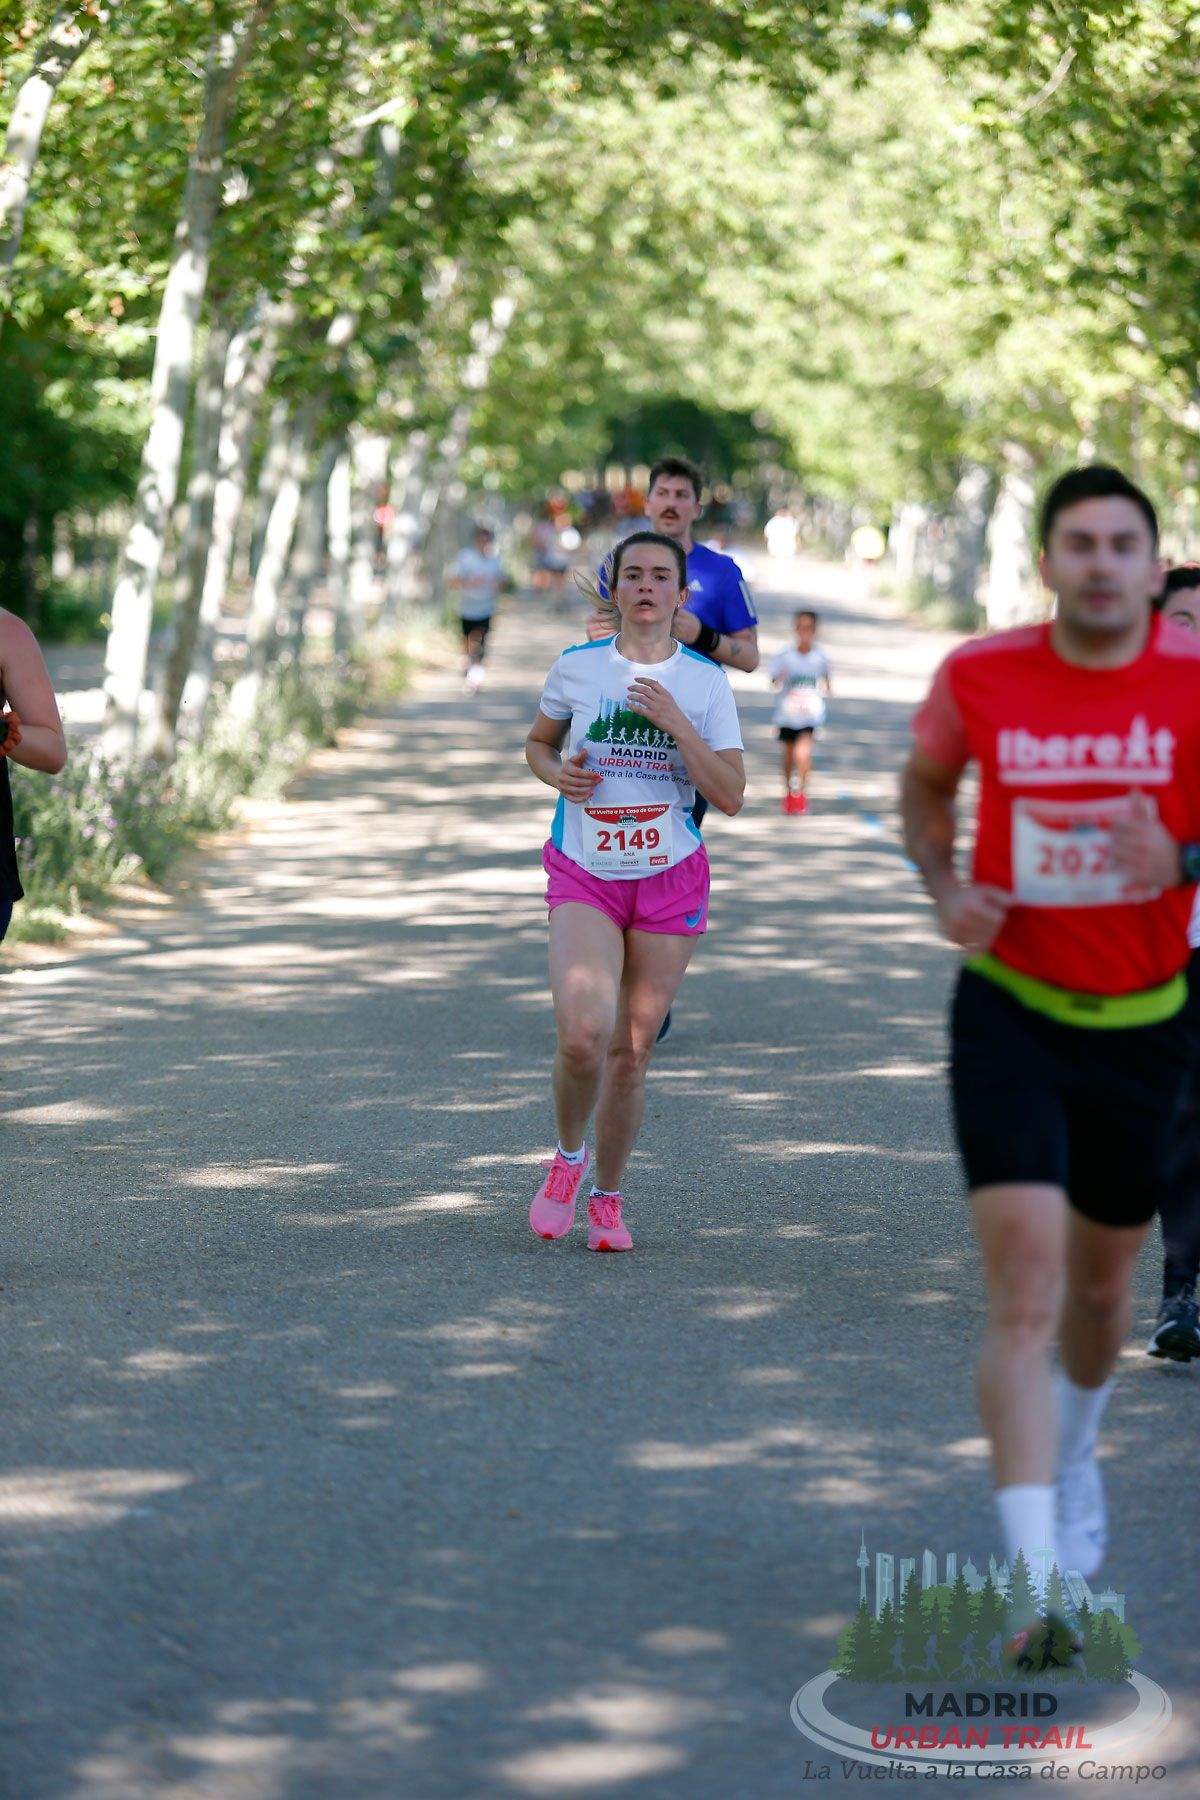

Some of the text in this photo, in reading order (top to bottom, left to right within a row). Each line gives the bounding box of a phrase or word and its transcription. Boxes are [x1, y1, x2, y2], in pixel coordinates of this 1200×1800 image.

[598, 757, 643, 768] URBAN
[611, 747, 668, 761] MADRID
[617, 769, 623, 777] a
[625, 770, 633, 778] la
[635, 771, 656, 781] Casa
[658, 773, 670, 782] de
[671, 774, 692, 787] amp
[597, 828, 660, 852] 2149
[1036, 844, 1113, 876] 202
